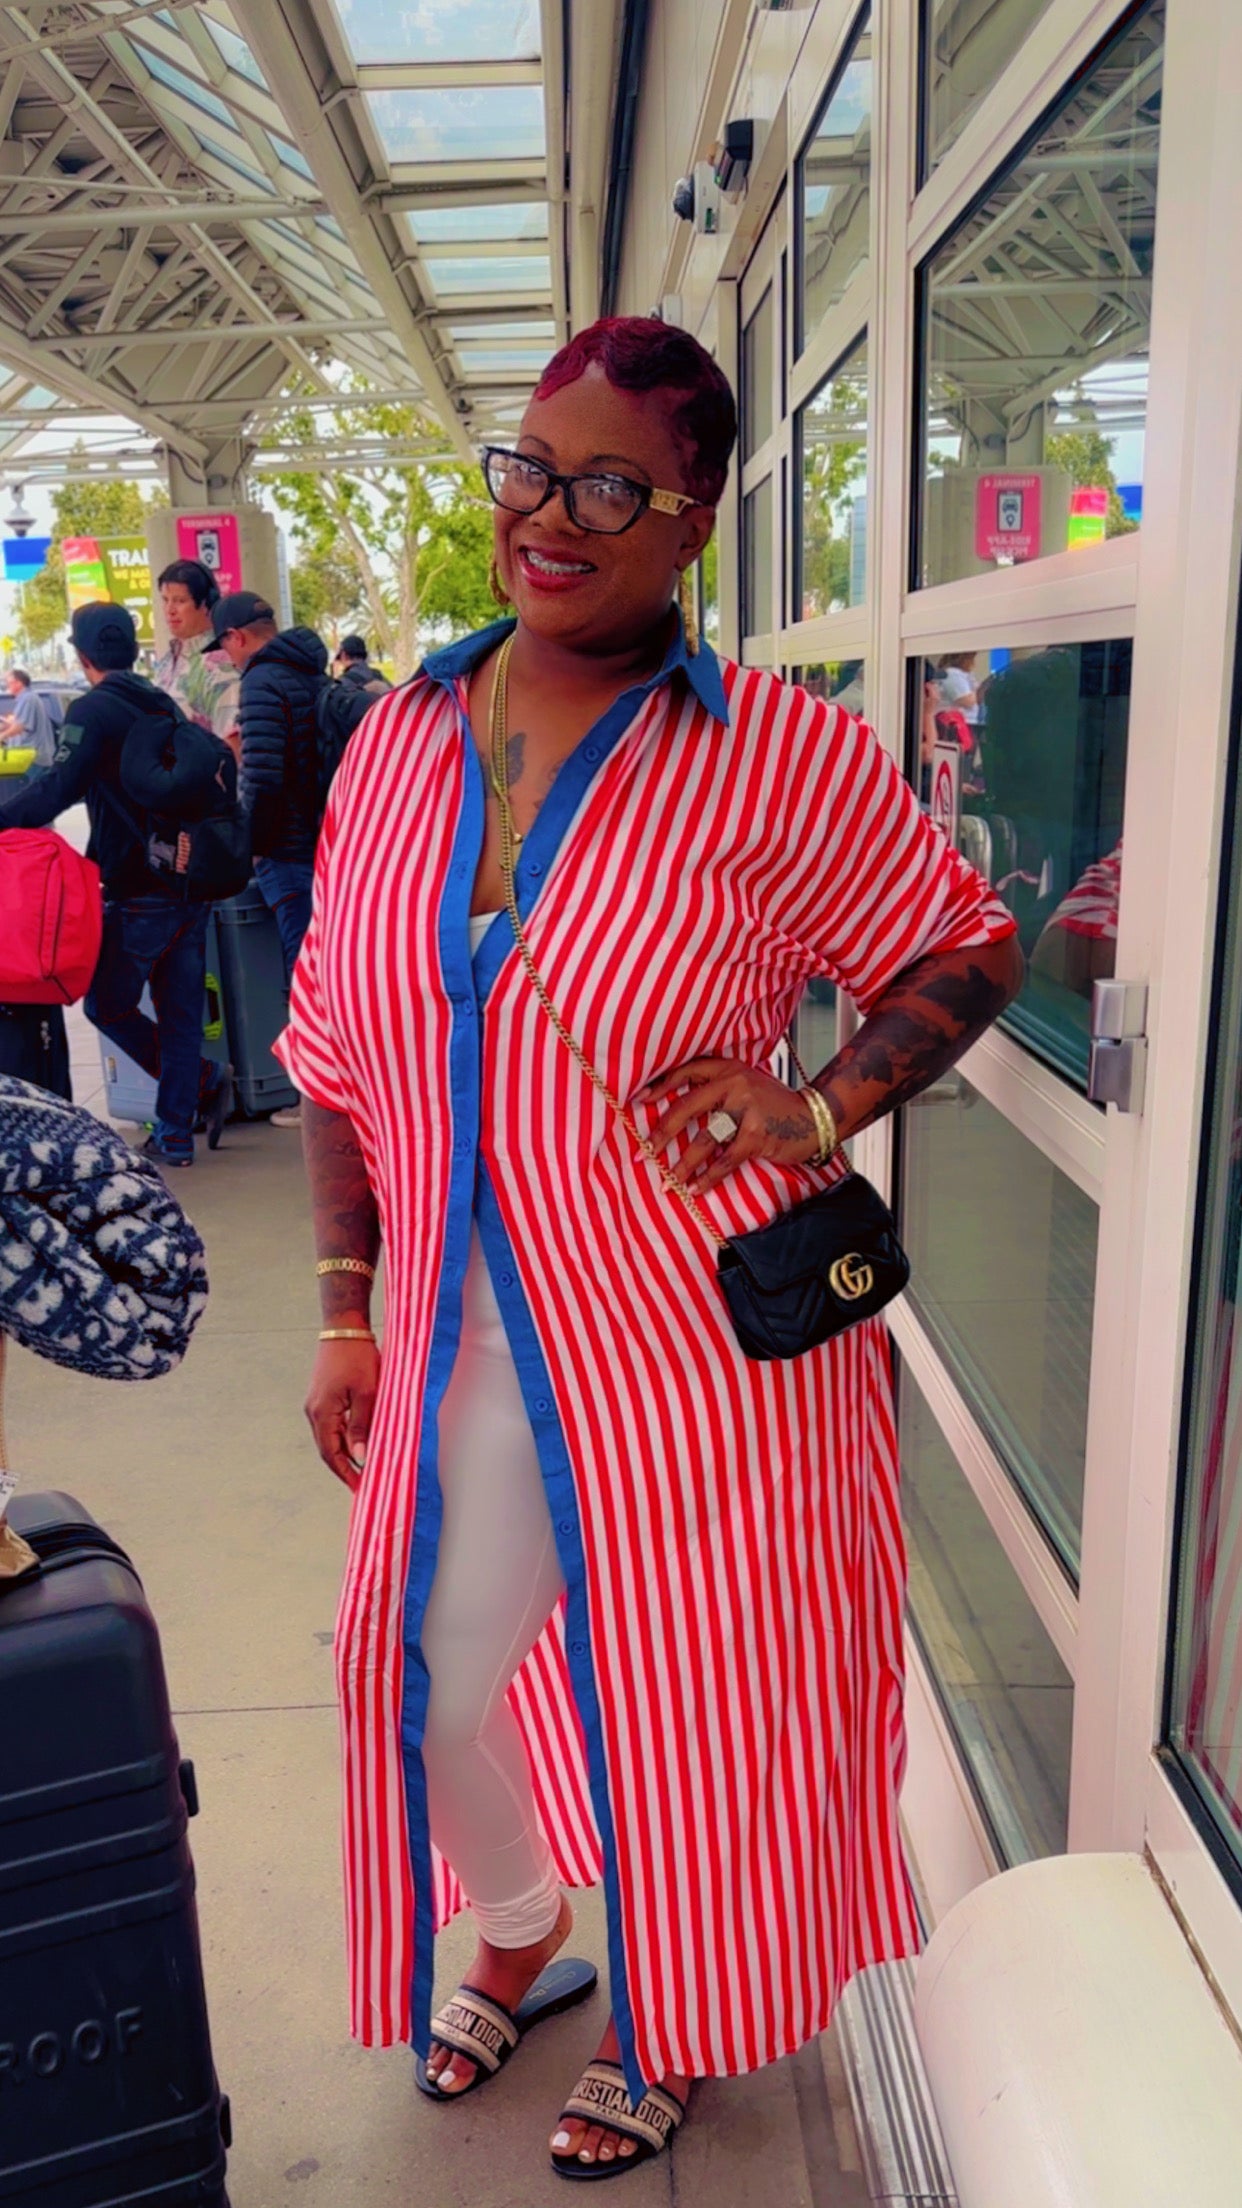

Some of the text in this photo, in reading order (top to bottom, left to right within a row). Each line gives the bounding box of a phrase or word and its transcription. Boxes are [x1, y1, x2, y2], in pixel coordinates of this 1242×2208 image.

[182, 518, 223, 528] TERMINAL
[471, 2017, 504, 2055] DIOR
[635, 2100, 672, 2138] DIOR
